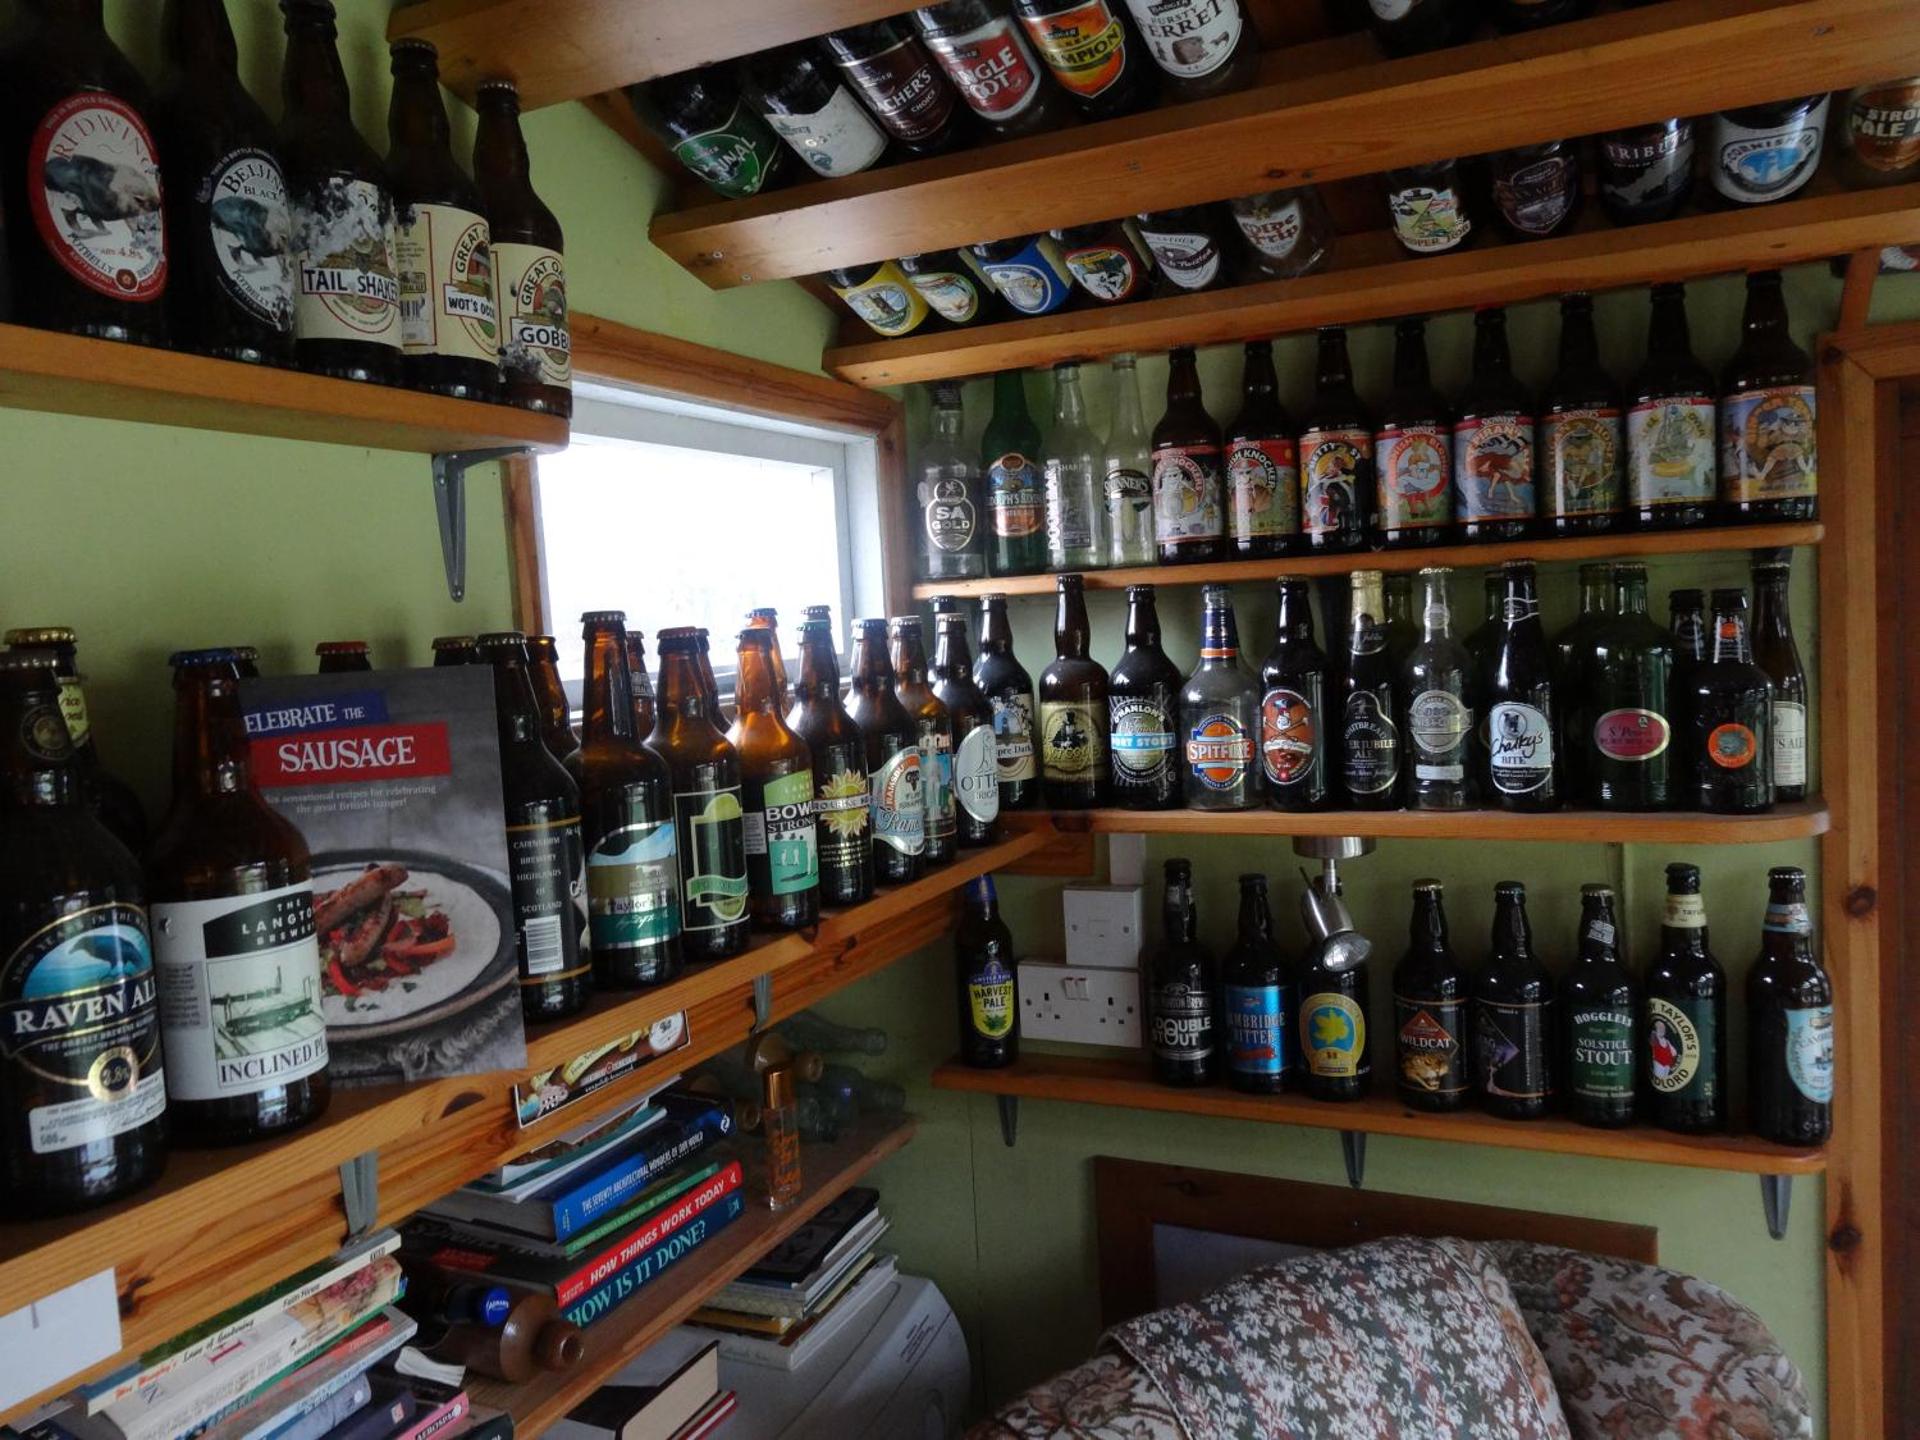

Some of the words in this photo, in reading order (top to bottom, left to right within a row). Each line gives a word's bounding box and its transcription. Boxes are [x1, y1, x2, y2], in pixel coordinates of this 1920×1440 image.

[456, 228, 480, 274] GREAT
[303, 269, 348, 292] TAIL
[521, 265, 549, 305] GREAT
[447, 296, 479, 314] WOT'S
[935, 506, 967, 520] SA
[932, 520, 970, 531] GOLD
[244, 703, 337, 734] ELEBRATE
[343, 706, 365, 721] THE
[278, 736, 417, 773] SAUSAGE
[1190, 741, 1252, 761] SPITFIRE
[283, 791, 332, 804] sensational
[335, 788, 368, 801] recipes
[385, 783, 437, 800] celebrating
[277, 900, 301, 912] THE
[973, 985, 1012, 999] HARVEST
[982, 996, 1006, 1009] PALE
[15, 991, 126, 1036] RAVEN
[1661, 1004, 1697, 1052] TAYLOR'S
[1400, 1035, 1452, 1049] WILDCAT
[1578, 1038, 1629, 1050] SOLSTICE
[221, 1043, 313, 1083] INCLINED
[1575, 1047, 1633, 1066] STOUT
[590, 1258, 619, 1284] HOW
[620, 1229, 658, 1260] THINGS
[660, 1206, 692, 1233] WORK
[693, 1180, 725, 1209] TODAY
[566, 1289, 613, 1328] HOW
[616, 1276, 633, 1299] IS
[635, 1258, 652, 1284] IT
[656, 1219, 706, 1269] DONE?
